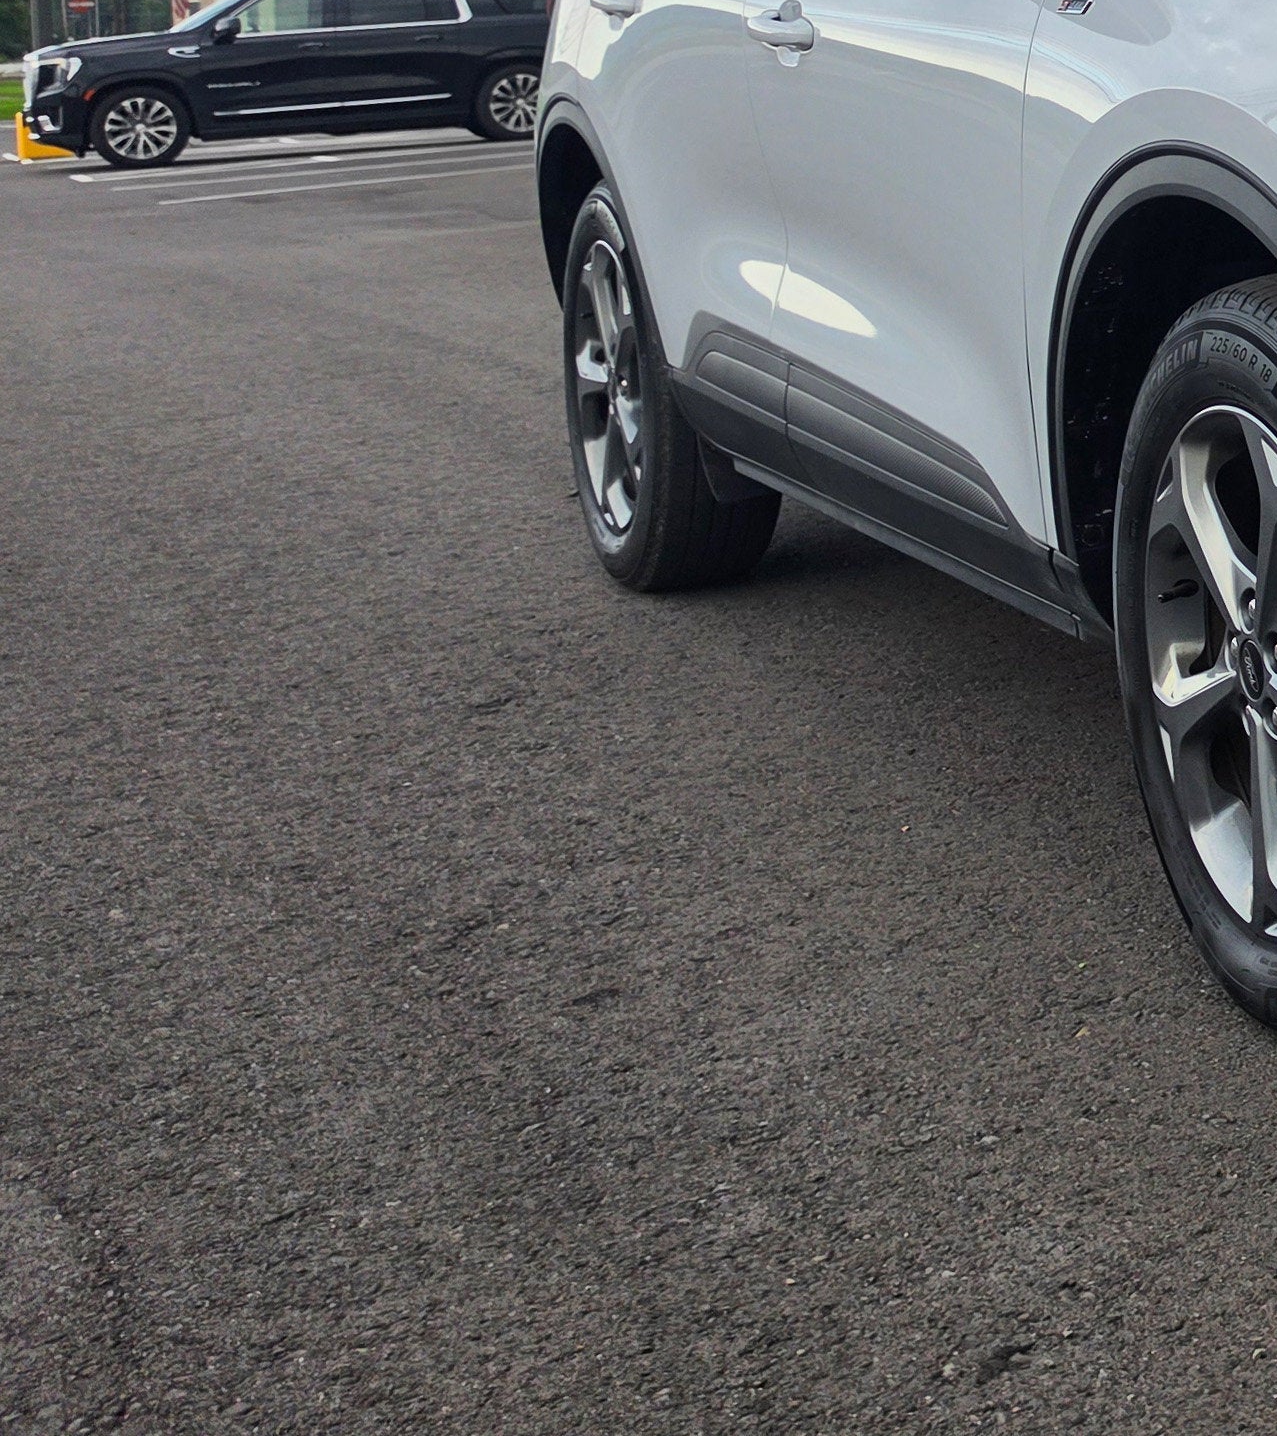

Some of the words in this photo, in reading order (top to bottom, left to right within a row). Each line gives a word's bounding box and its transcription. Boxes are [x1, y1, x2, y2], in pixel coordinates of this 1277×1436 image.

[1210, 336, 1247, 362] 225/60
[1248, 354, 1258, 371] R
[1259, 364, 1273, 383] 18
